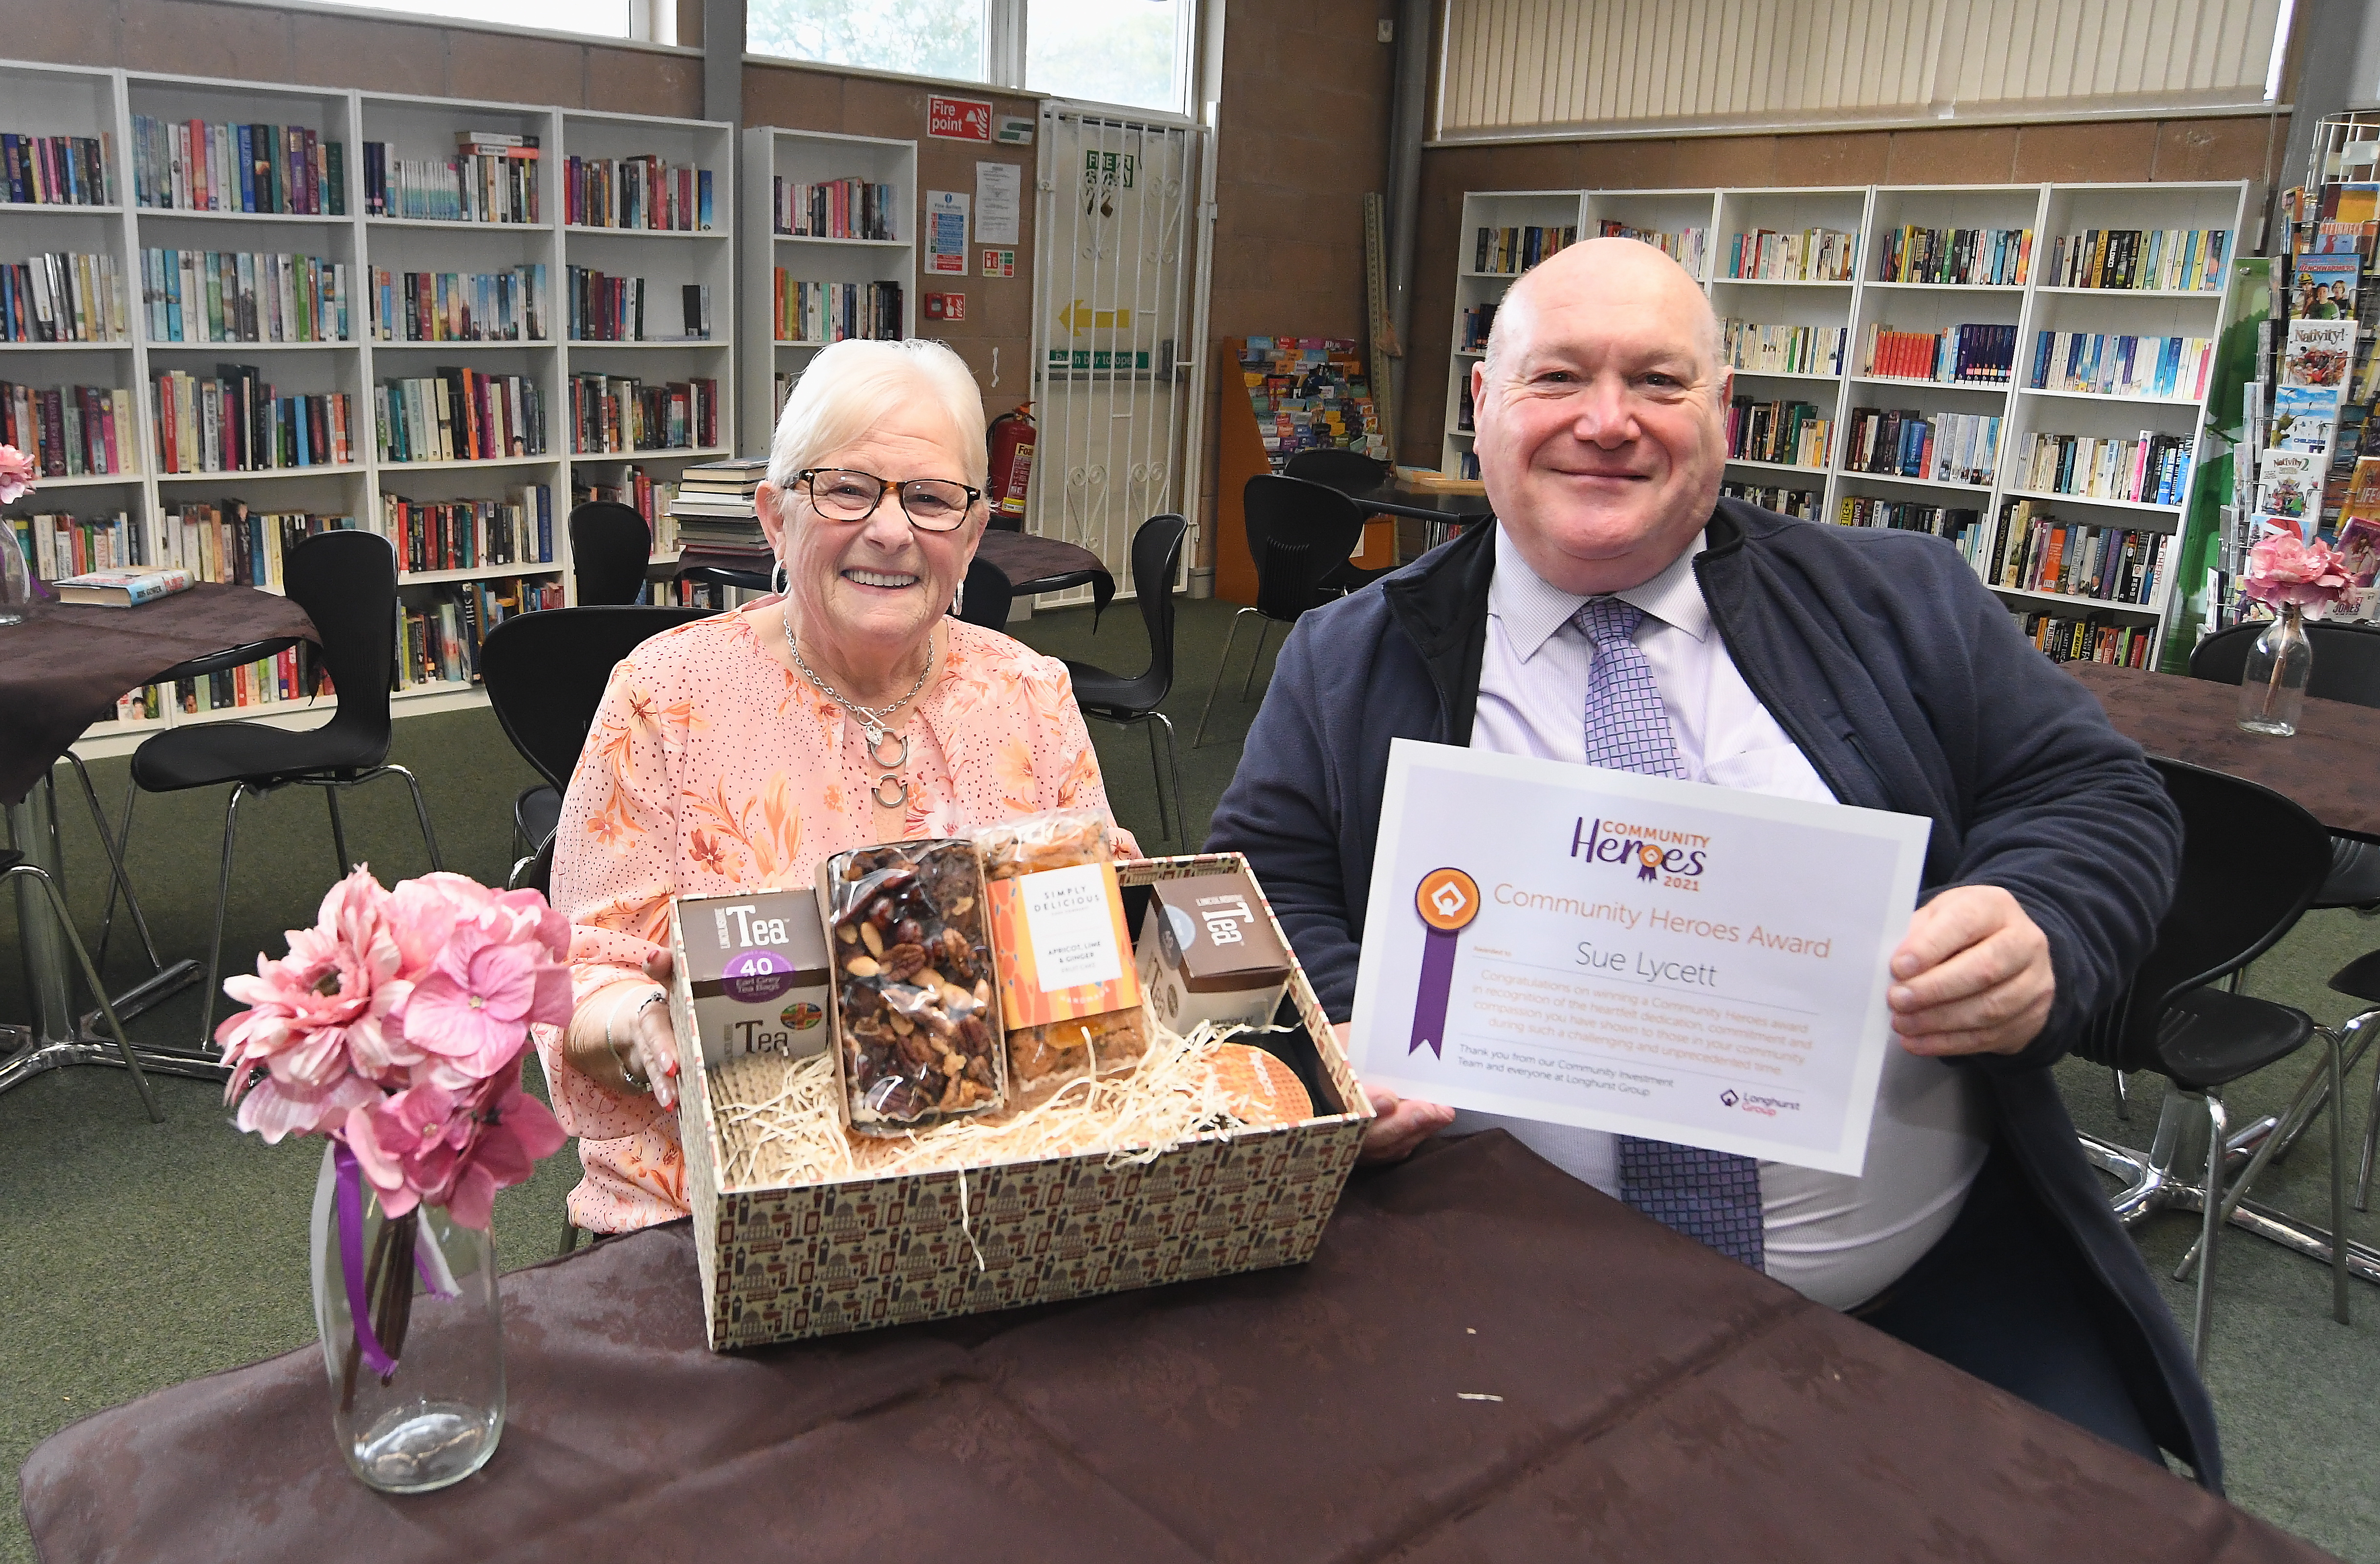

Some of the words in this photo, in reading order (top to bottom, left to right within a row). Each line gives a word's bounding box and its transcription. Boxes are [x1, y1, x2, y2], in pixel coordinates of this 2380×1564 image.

[933, 100, 956, 116] Fire
[933, 117, 962, 132] point
[1089, 153, 1113, 169] FIE
[1084, 353, 1100, 365] br
[2073, 539, 2083, 557] Price
[2071, 557, 2080, 577] Katie
[2152, 551, 2164, 586] CHERYL
[465, 598, 475, 626] SHIP
[2073, 636, 2081, 656] MARTIN
[2080, 651, 2090, 661] FA
[1603, 821, 1710, 848] COMMUNITY
[1571, 817, 1707, 876] Heroes
[1044, 886, 1086, 900] SIMPLY
[1664, 875, 1699, 892] 2021
[1034, 894, 1100, 913] DELICIOUS
[725, 904, 789, 947] Tea
[1202, 901, 1255, 947] Tea
[1494, 882, 1642, 930] Community
[1650, 907, 1740, 943] Heroes
[1747, 925, 1832, 959] Award
[740, 957, 773, 977] 40
[1576, 941, 1626, 971] Sue
[1637, 951, 1719, 987] Lycett
[1482, 969, 1571, 993] Congratulations
[1573, 986, 1590, 995] on
[1652, 997, 1721, 1020] Community
[1725, 1010, 1768, 1026] Heroes
[1459, 1043, 1488, 1057] Thank
[1490, 1050, 1510, 1060] you
[1512, 1053, 1536, 1065] from
[1538, 1057, 1555, 1067] our
[1558, 1059, 1617, 1079] Community
[1618, 1070, 1674, 1088] Investment
[1458, 1055, 1484, 1069] Team
[1486, 1062, 1505, 1072] and
[1507, 1066, 1552, 1081] everyone
[1554, 1074, 1564, 1082] at
[1566, 1075, 1616, 1091] Longhurst
[1618, 1082, 1651, 1097] Group
[1742, 1101, 1776, 1117] Group
[1744, 1091, 1800, 1111] Longhurst
